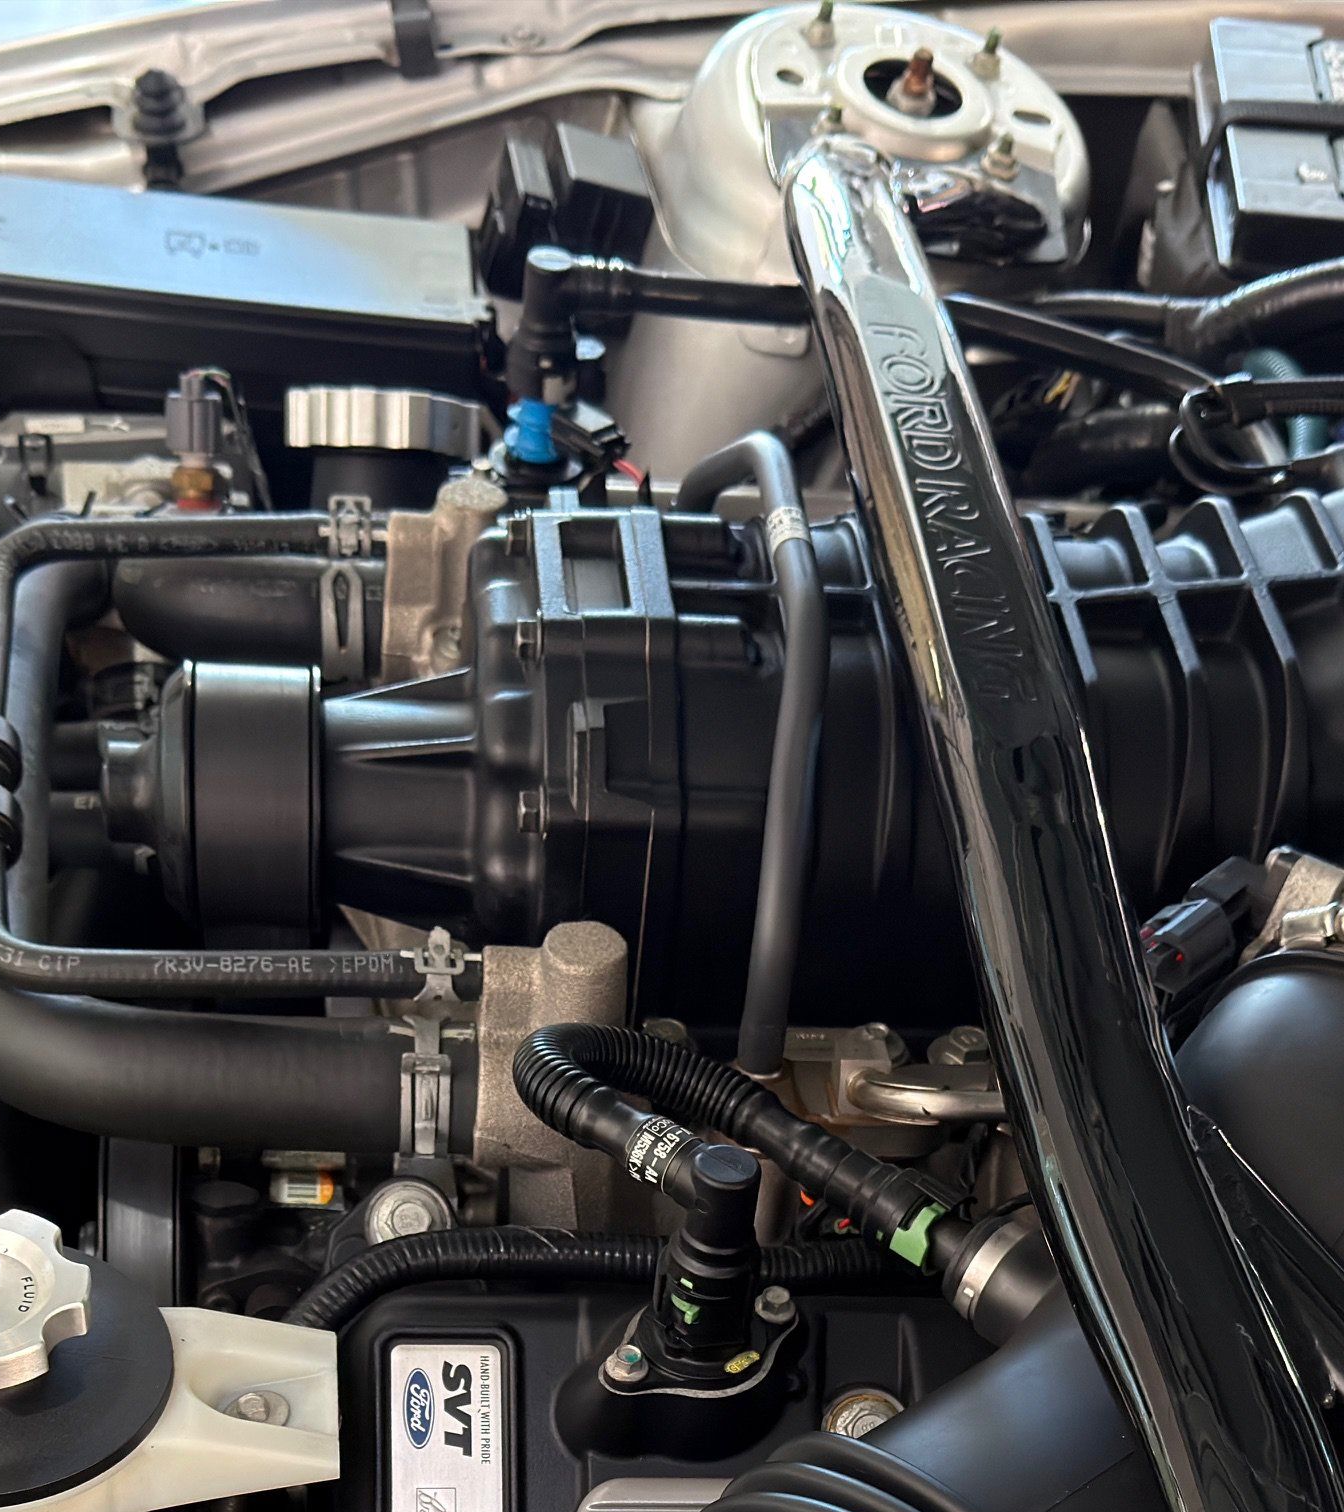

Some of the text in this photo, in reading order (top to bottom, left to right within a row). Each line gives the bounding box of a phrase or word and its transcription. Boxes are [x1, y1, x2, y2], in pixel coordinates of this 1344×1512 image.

[17, 1275, 35, 1313] FLUID
[441, 1360, 474, 1458] SVT
[478, 1355, 491, 1466] HAND-BUILT WITH PRIDE
